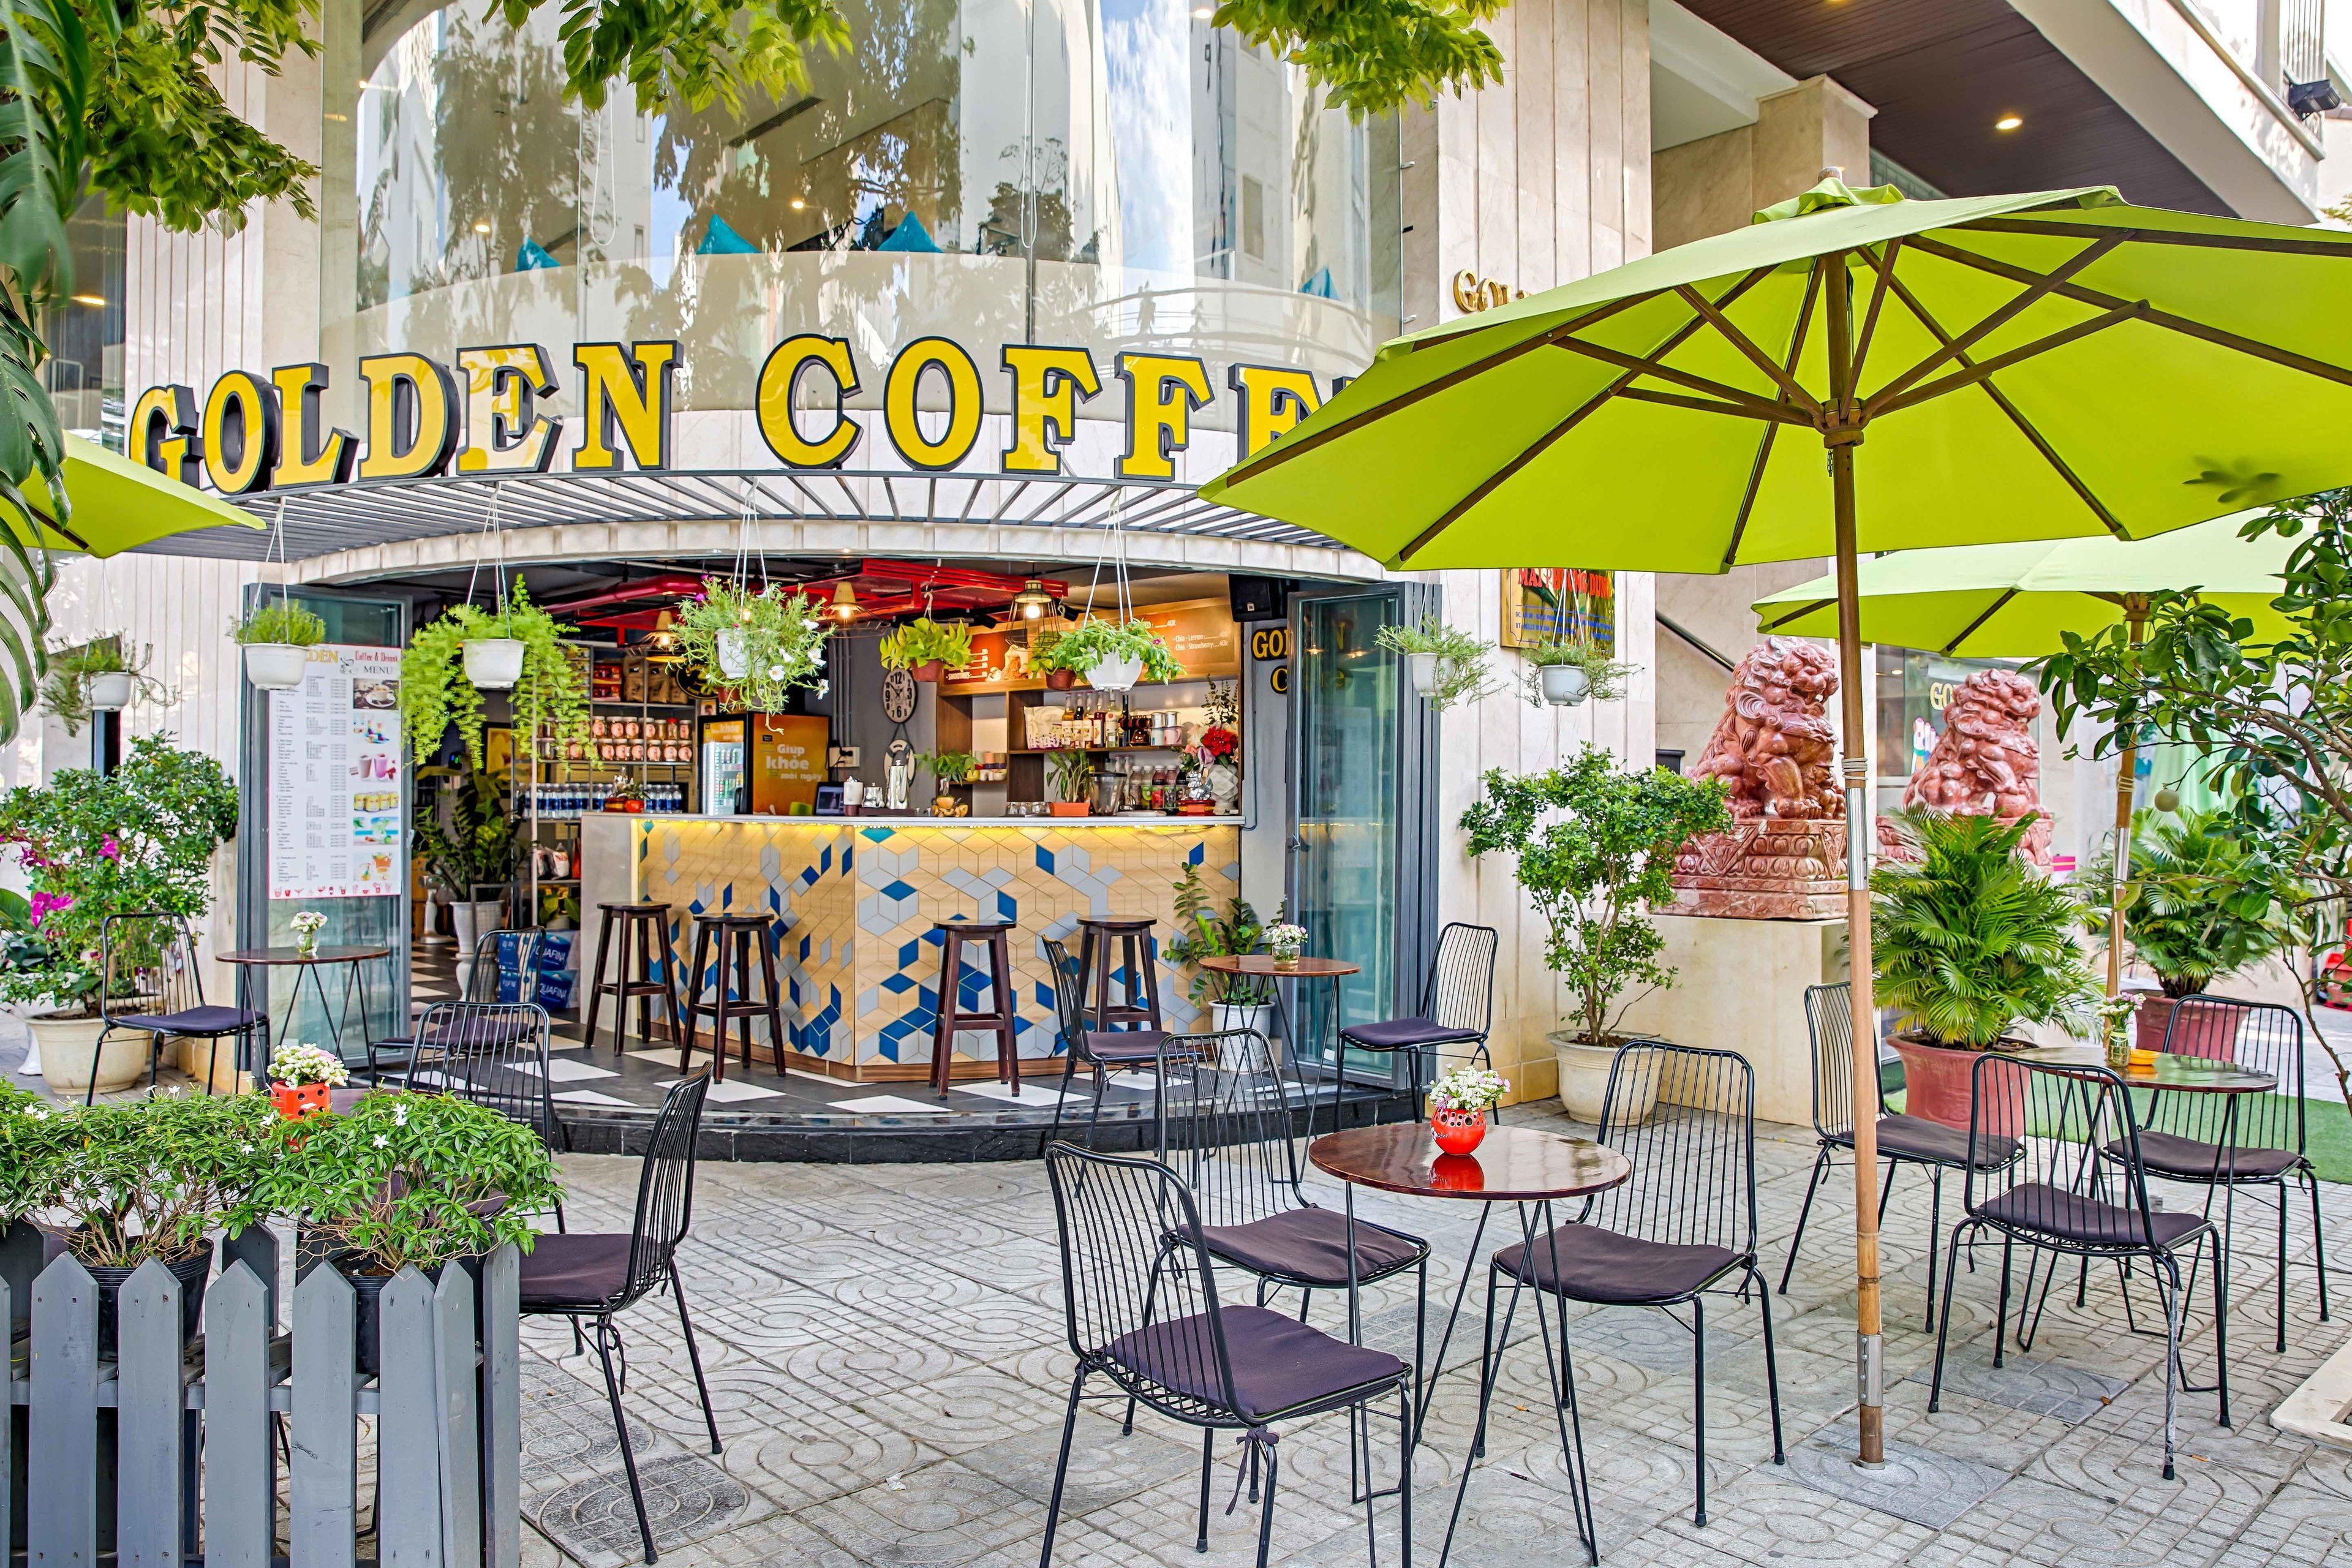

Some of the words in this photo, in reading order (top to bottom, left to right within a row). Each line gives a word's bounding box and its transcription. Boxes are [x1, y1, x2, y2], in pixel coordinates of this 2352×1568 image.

[129, 340, 684, 493] GOLDEN
[755, 333, 1356, 481] COFFE
[894, 671, 902, 684] 12
[885, 690, 890, 702] 9
[907, 688, 912, 699] 3
[897, 706, 902, 718] 6
